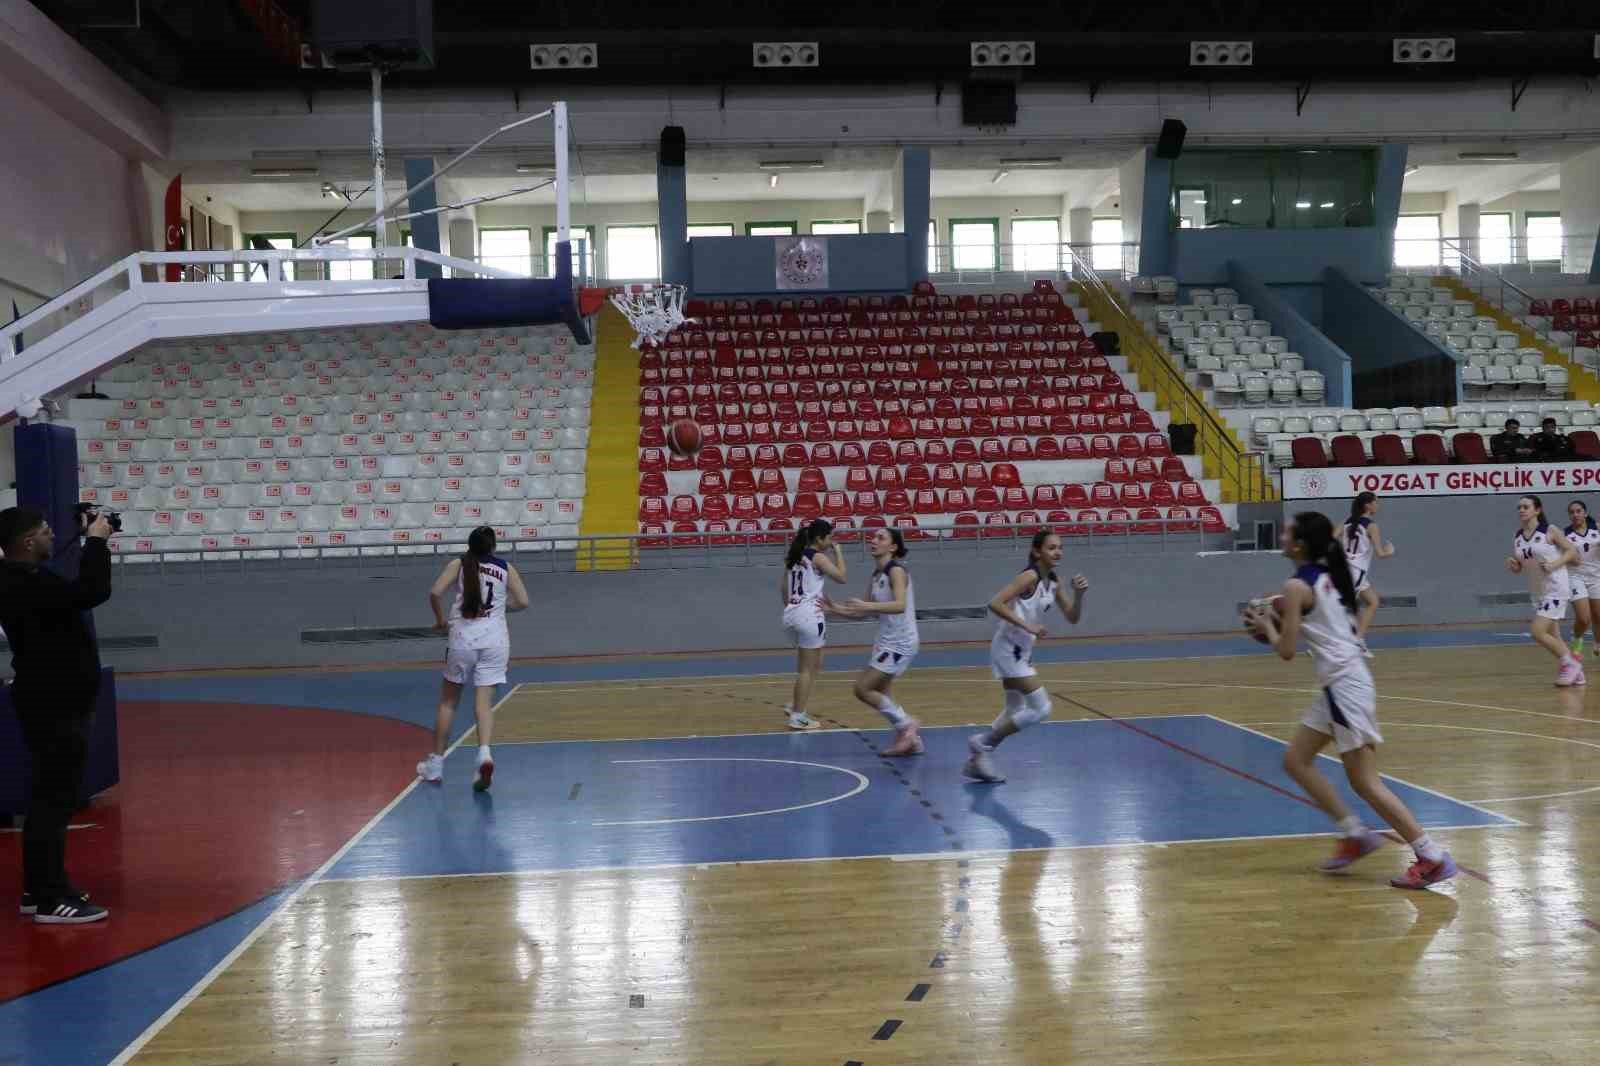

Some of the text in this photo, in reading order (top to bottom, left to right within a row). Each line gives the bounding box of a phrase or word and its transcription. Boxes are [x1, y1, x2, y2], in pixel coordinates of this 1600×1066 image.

[1348, 472, 1440, 492] YOZGAT
[1445, 466, 1533, 492] GENÇLİK
[1540, 469, 1566, 487] VE
